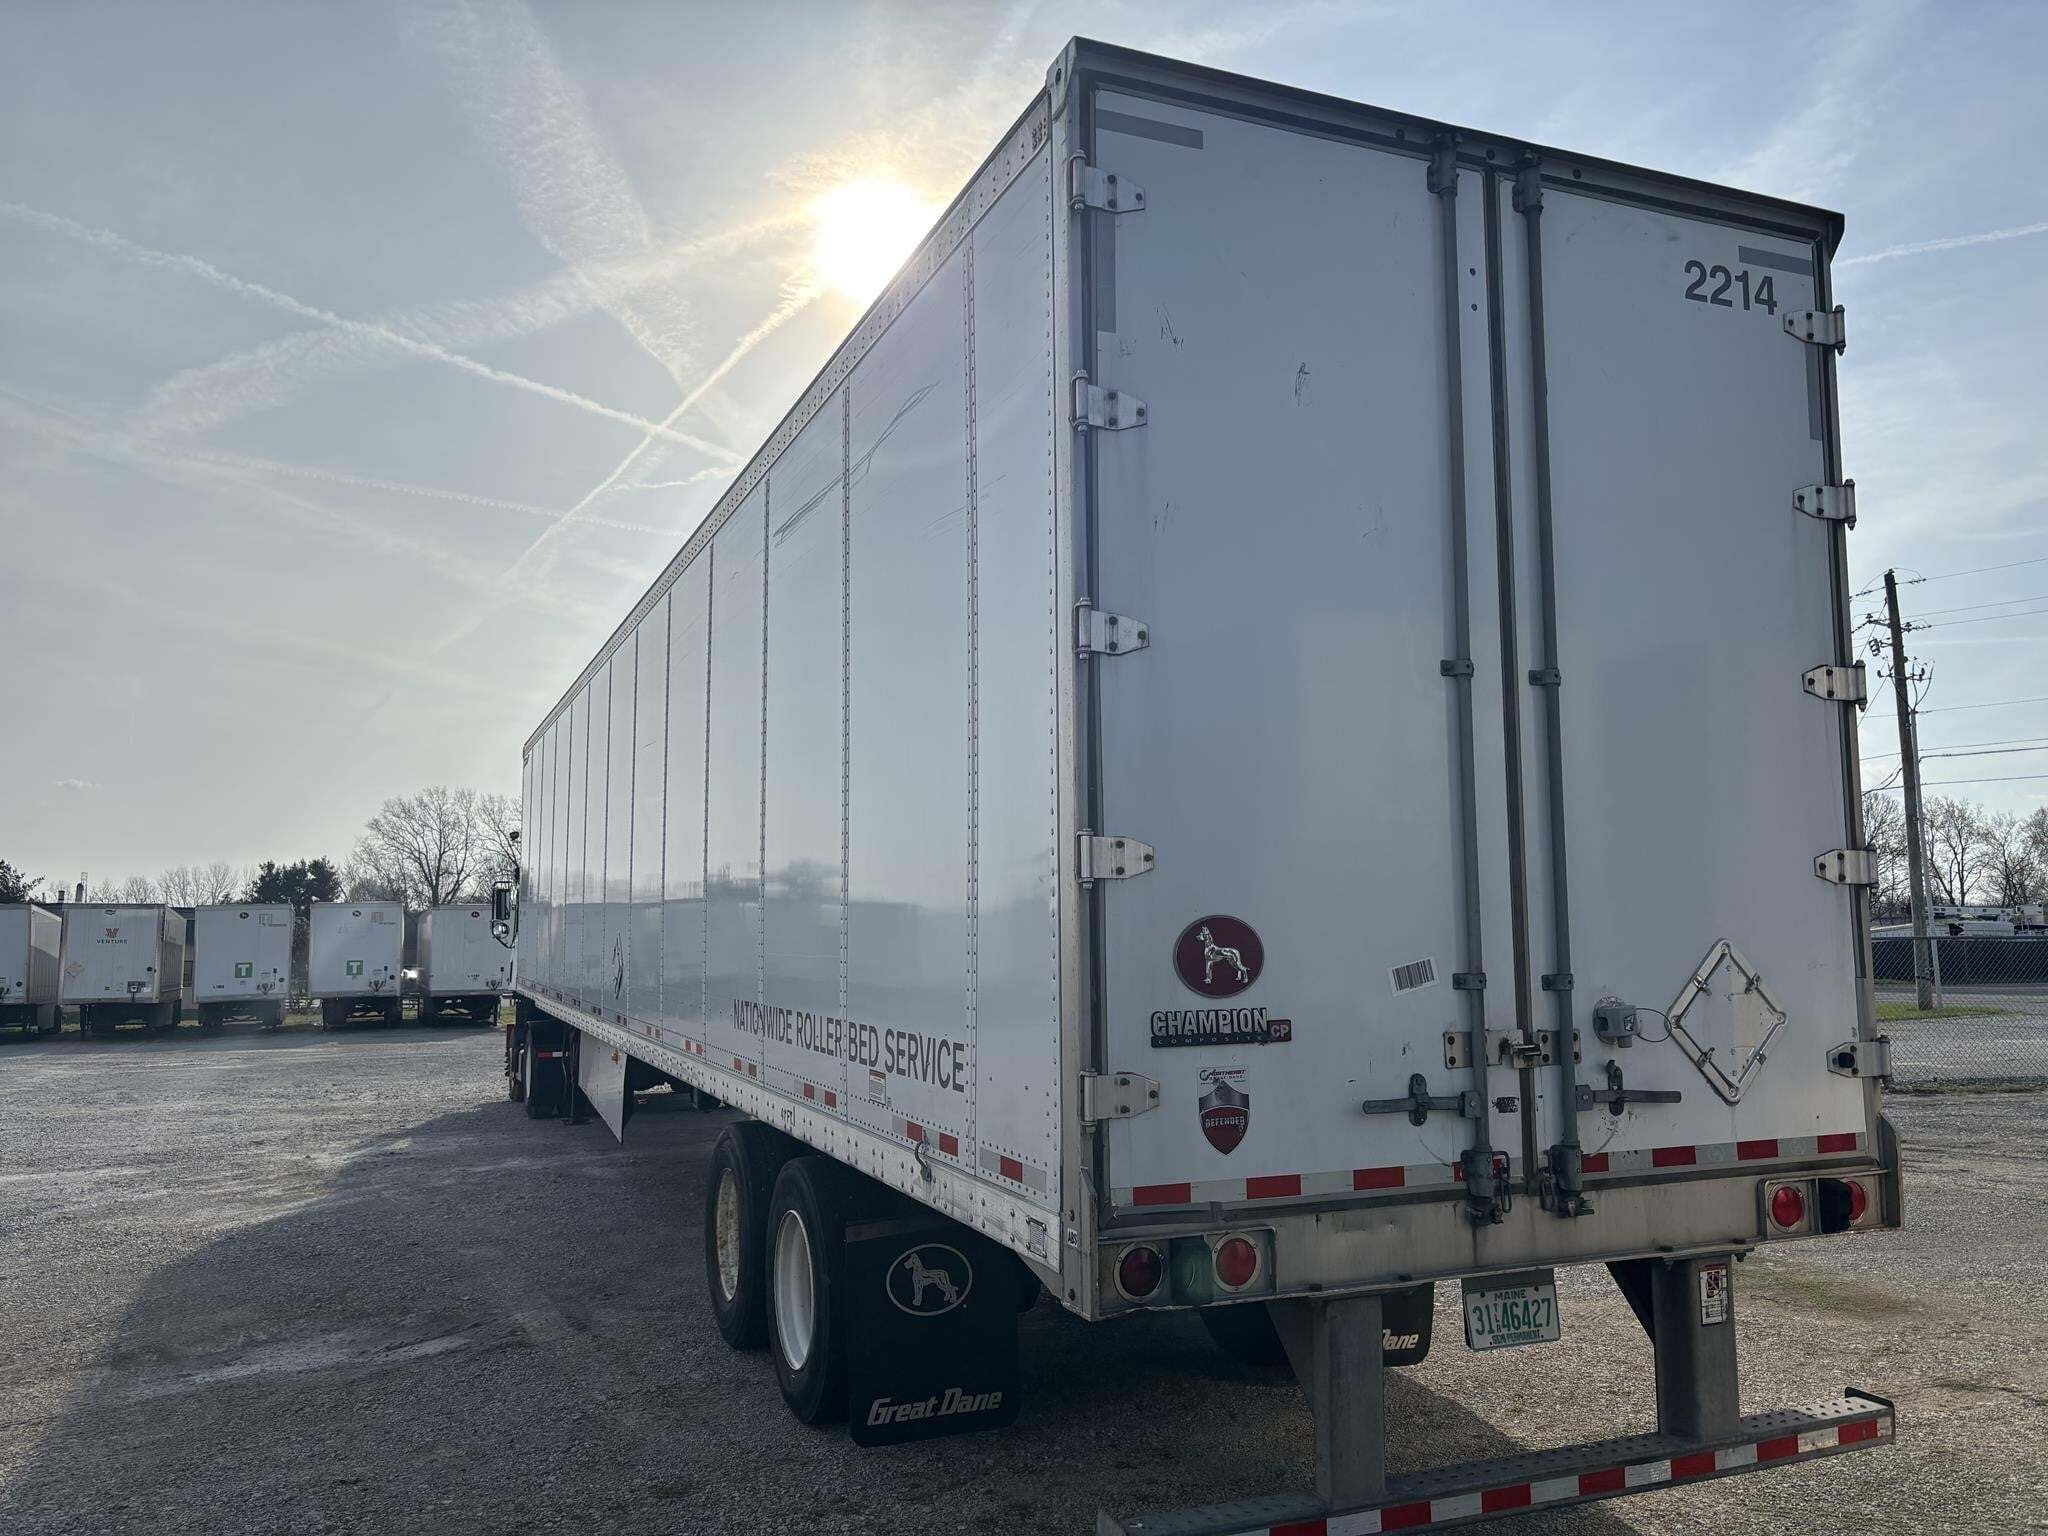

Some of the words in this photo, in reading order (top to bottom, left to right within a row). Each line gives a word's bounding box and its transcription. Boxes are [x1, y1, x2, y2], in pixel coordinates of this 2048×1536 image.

[1684, 260, 1777, 315] 2214
[1151, 1008, 1267, 1037] CHAMPION
[1270, 1024, 1289, 1038] CP
[733, 999, 792, 1045] NATIONWIDE
[796, 1011, 843, 1059] ROLLER
[849, 1021, 879, 1068] BED
[884, 1028, 965, 1093] SERVICE
[1068, 1230, 1078, 1246] ABS
[1494, 1289, 1527, 1301] MAINE
[867, 1397, 938, 1426] Great
[937, 1387, 1002, 1416] Dane
